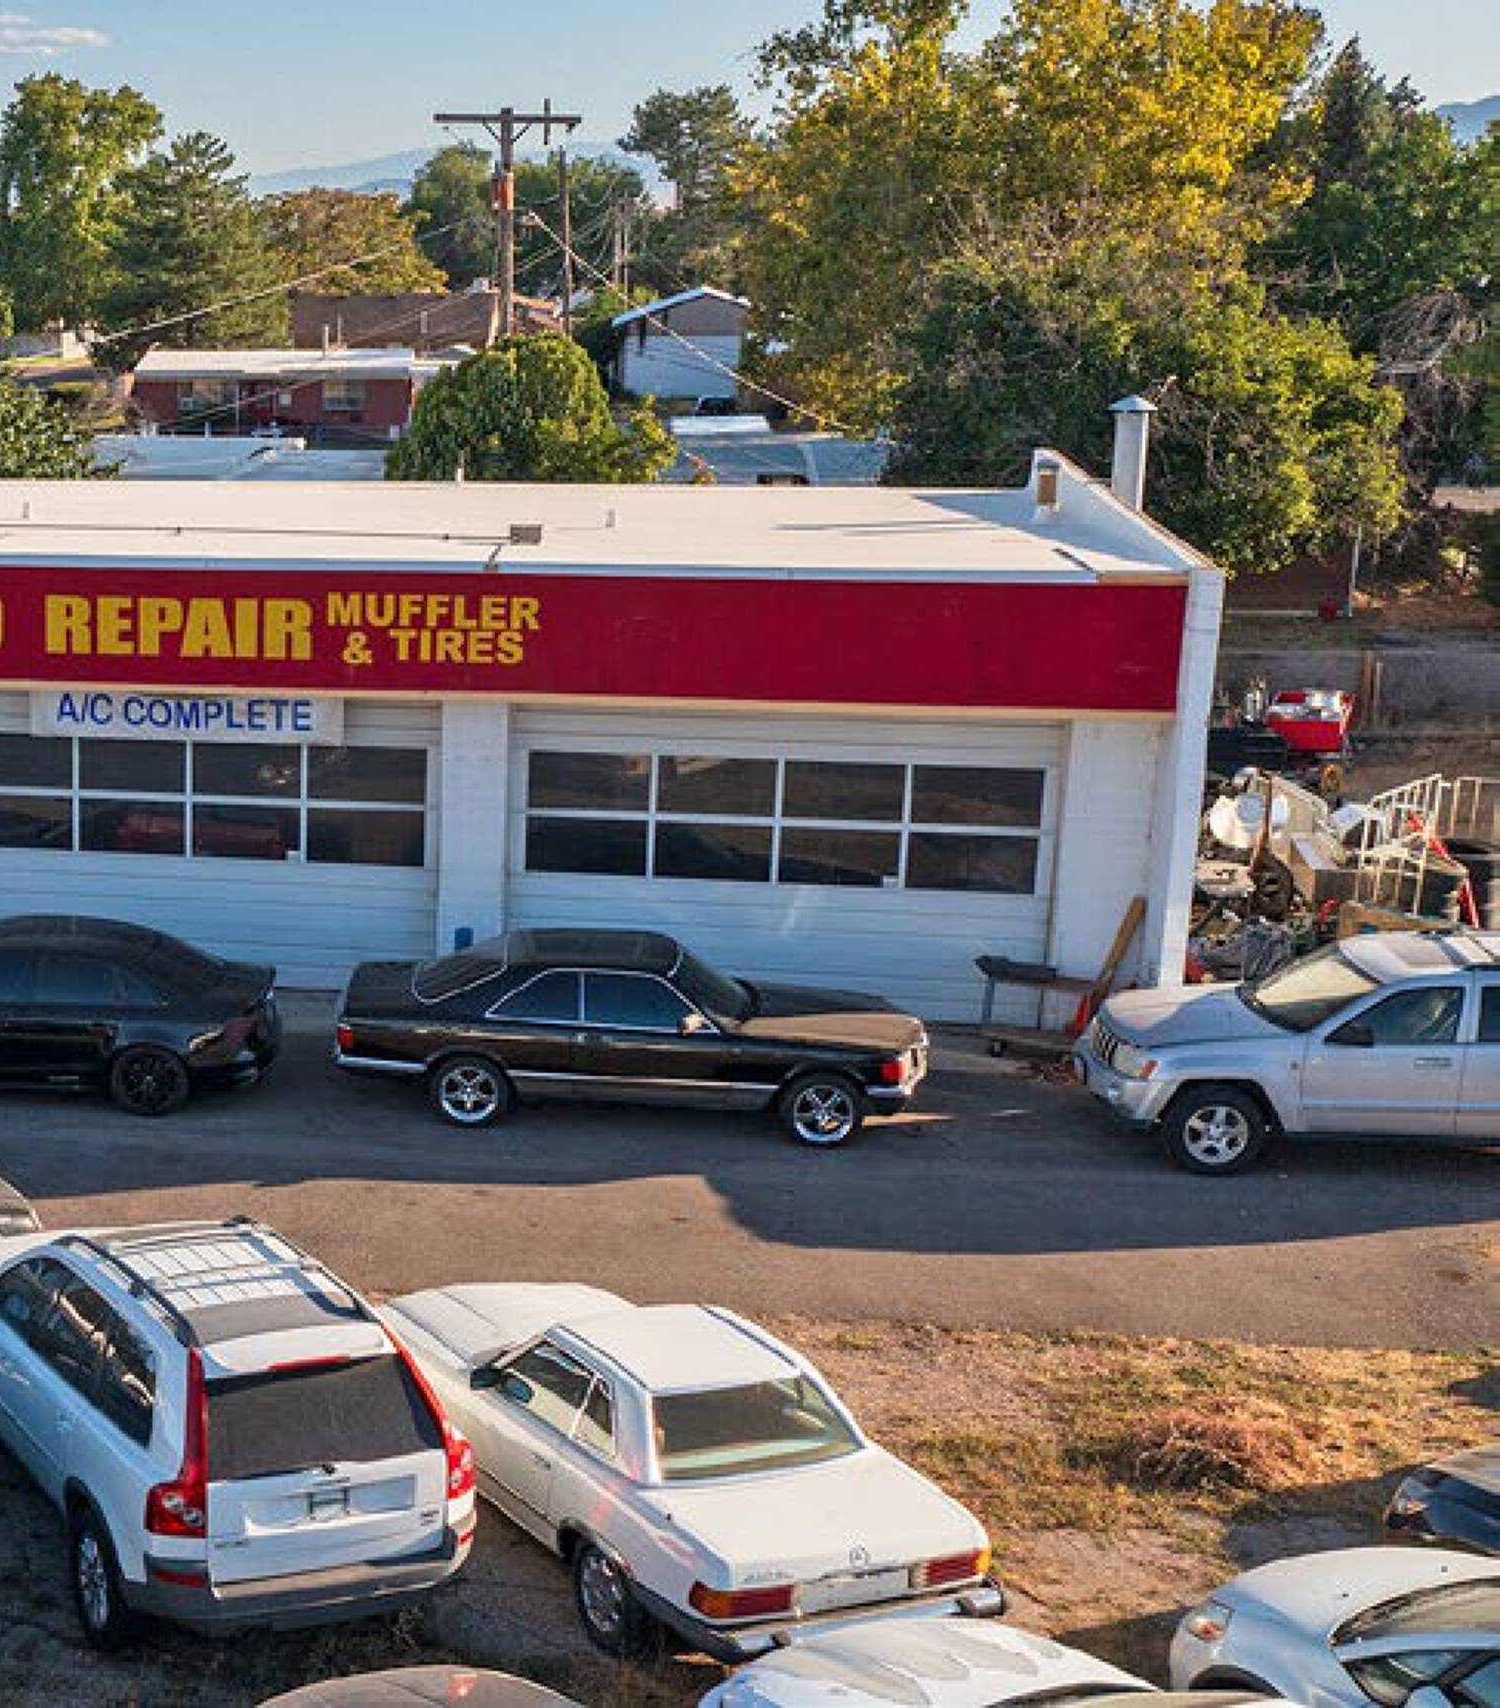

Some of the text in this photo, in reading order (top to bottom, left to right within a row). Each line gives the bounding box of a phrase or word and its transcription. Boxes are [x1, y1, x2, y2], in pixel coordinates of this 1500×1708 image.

[44, 593, 313, 660] REPAIR
[327, 591, 540, 630] MUFFLER
[342, 629, 524, 664] & TIRES
[56, 692, 313, 732] A/C COMPLETE
